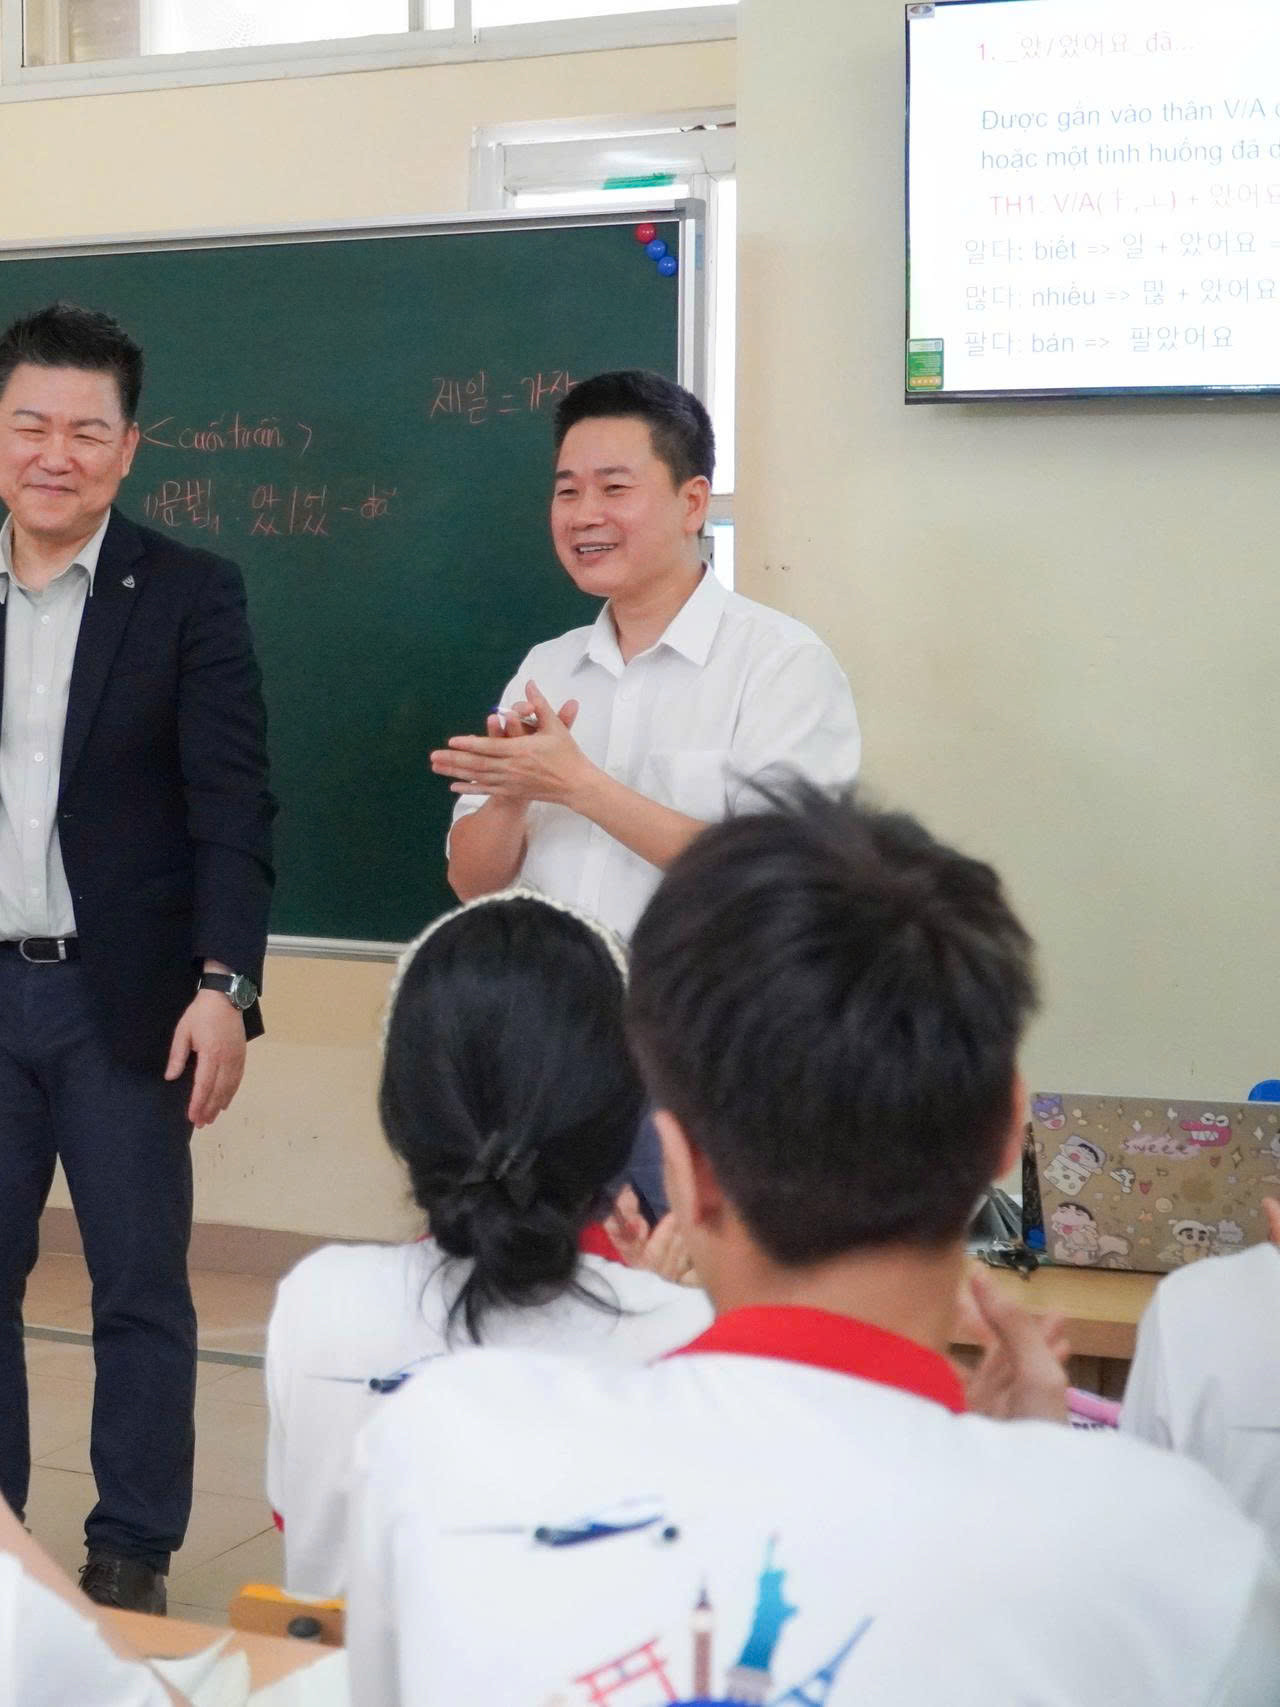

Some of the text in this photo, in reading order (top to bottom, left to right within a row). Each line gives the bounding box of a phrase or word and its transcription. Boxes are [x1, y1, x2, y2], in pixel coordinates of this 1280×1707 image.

[982, 109, 1048, 133] Được
[1110, 103, 1152, 124] vào
[1163, 100, 1212, 122] thân
[1223, 98, 1266, 120] V/A
[1046, 145, 1088, 171] một
[1150, 137, 1222, 166] huống
[1034, 234, 1078, 260] biết
[1031, 281, 1097, 307] nhiều
[1031, 333, 1076, 354] bán
